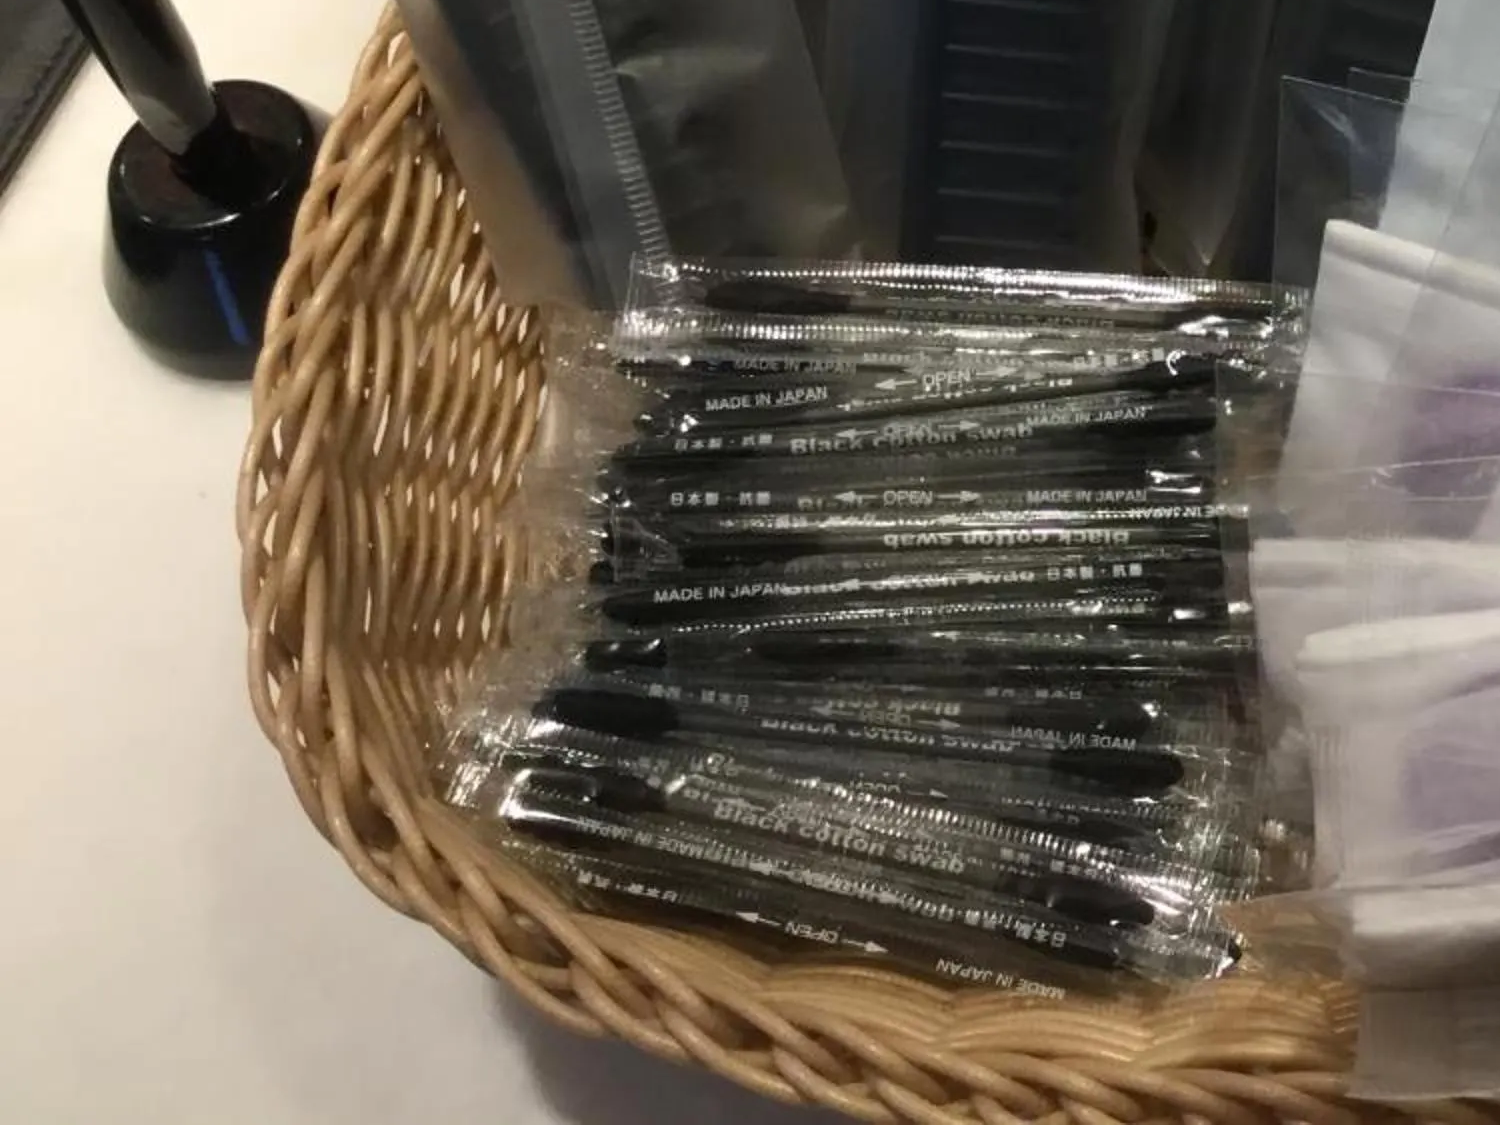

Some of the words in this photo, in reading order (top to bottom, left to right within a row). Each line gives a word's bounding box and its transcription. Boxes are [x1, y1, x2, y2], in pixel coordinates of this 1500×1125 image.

[705, 395, 751, 412] MADE
[756, 393, 772, 407] IN
[776, 385, 828, 406] JAPAN
[1095, 406, 1148, 422] JAPAN
[883, 490, 933, 505] OPEN
[1026, 490, 1073, 504] MADE
[1075, 490, 1092, 503] IN
[1096, 489, 1148, 504] JAPAN
[654, 587, 703, 603] MADE
[708, 585, 726, 599] IN
[730, 582, 786, 599] JAPAN
[784, 921, 841, 945] OPEN
[935, 958, 994, 983] JAPAN
[995, 971, 1013, 988] IN
